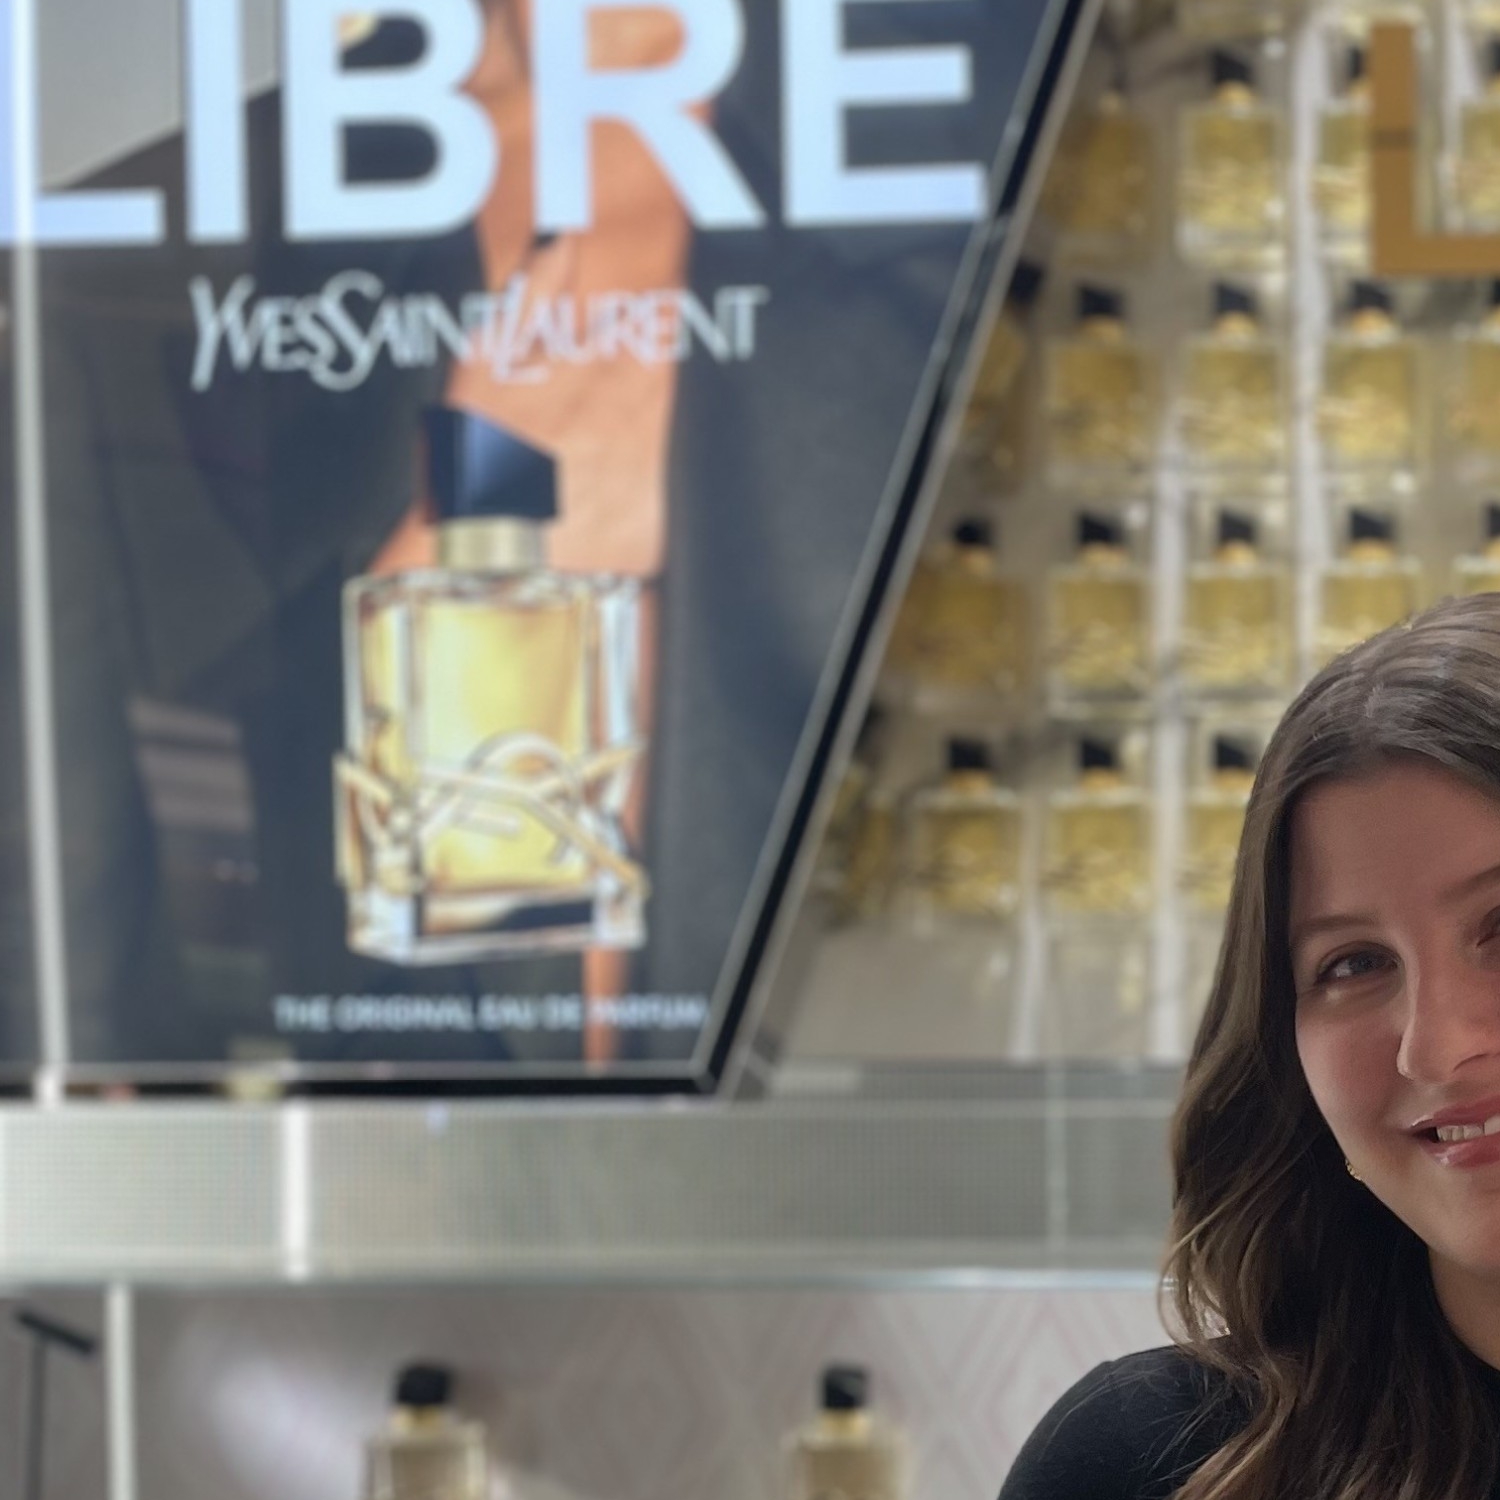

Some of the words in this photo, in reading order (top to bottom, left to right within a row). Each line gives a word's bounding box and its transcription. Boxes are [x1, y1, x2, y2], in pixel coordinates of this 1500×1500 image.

[0, 0, 988, 247] LIBRE
[274, 994, 331, 1033] THE
[335, 993, 475, 1034] ORIGINAL
[478, 993, 536, 1033] EAU
[543, 993, 582, 1032] DE
